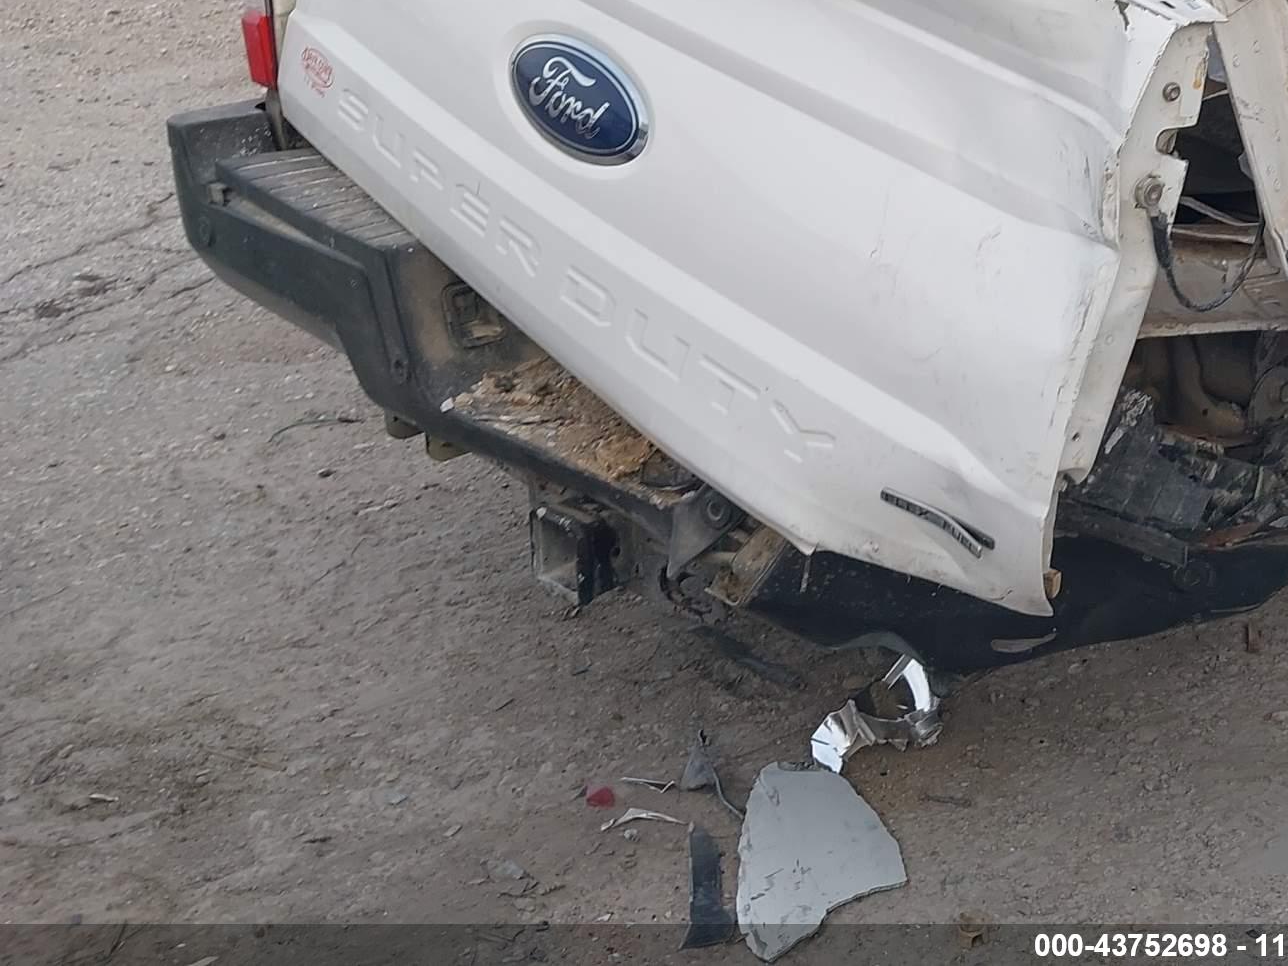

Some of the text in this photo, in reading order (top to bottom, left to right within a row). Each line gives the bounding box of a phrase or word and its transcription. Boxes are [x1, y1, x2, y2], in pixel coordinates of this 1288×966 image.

[528, 56, 610, 140] Ford
[337, 87, 838, 464] SUPER DUTY
